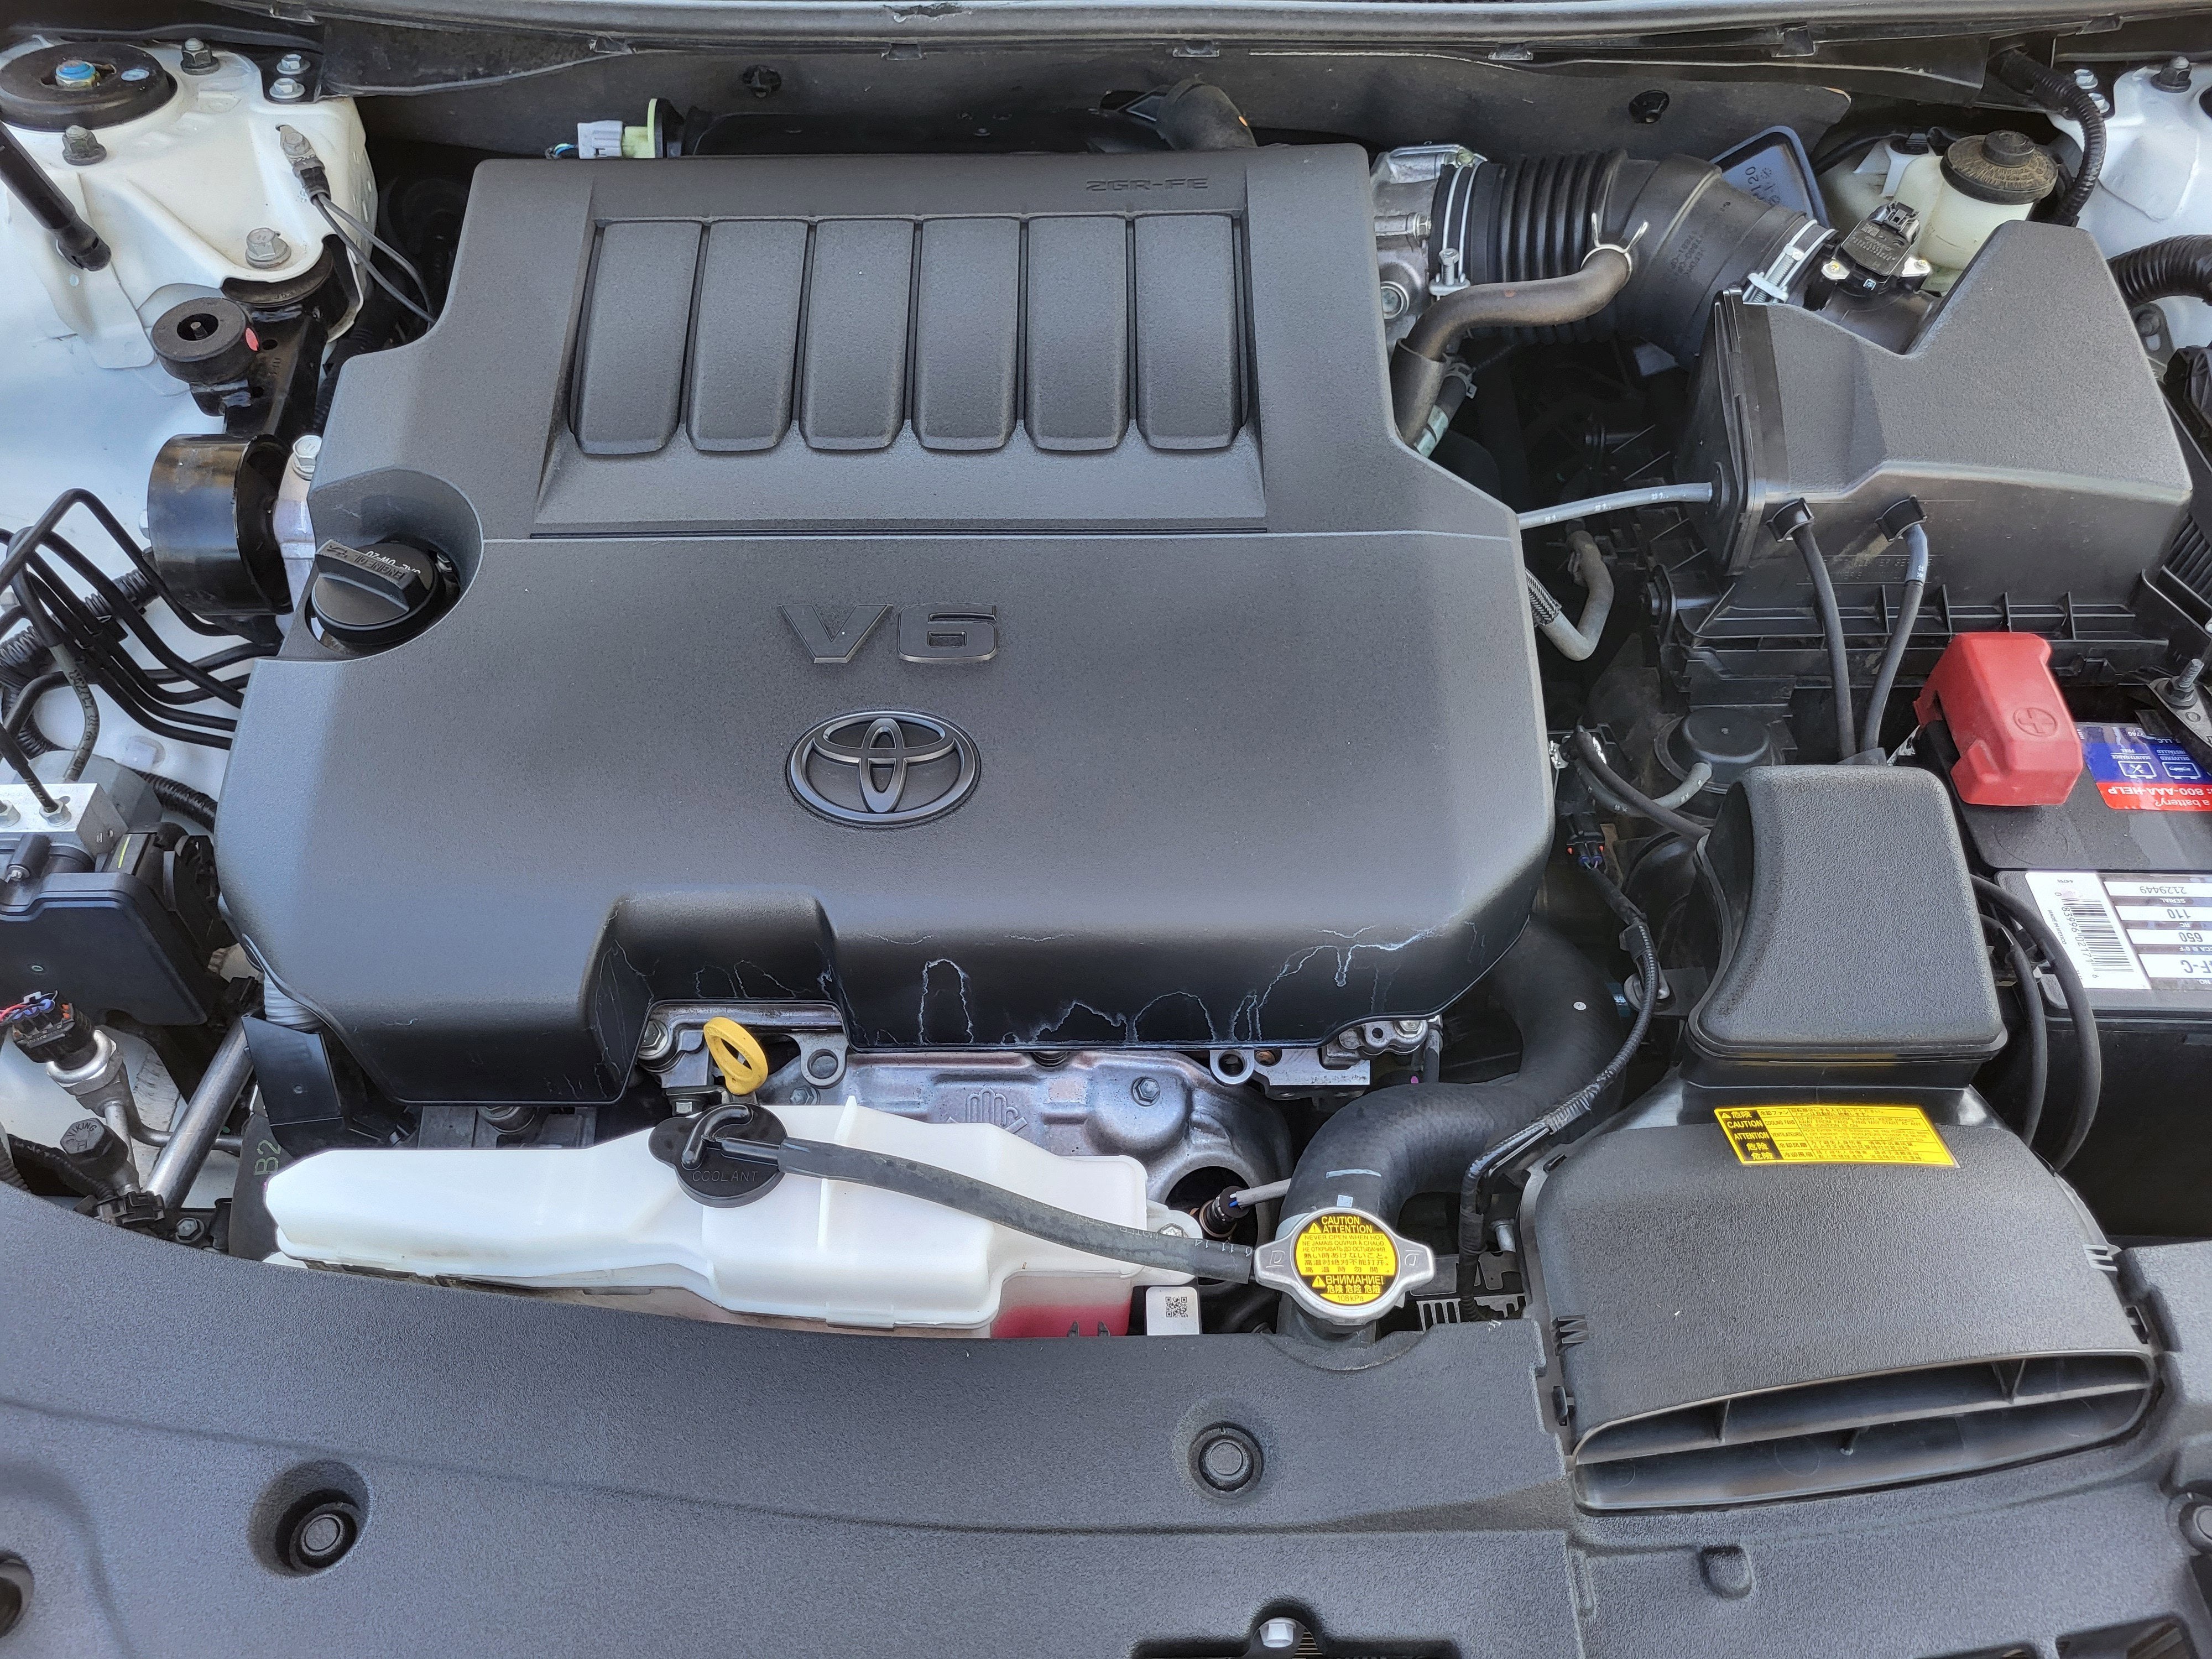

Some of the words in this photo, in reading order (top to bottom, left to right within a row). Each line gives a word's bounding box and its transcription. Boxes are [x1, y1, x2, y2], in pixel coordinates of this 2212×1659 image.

[1086, 179, 1208, 191] 2GR-FE
[353, 554, 368, 566] OIL
[368, 560, 405, 580] ENGINE
[778, 603, 998, 664] V6
[2107, 786, 2205, 795] 800-AAA-HELP
[2154, 799, 2201, 807] battery?
[2140, 885, 2187, 894] 2129449
[2167, 909, 2192, 919] 110
[2048, 910, 2056, 922] MADE
[2055, 927, 2067, 945] MEXICO
[2061, 906, 2078, 932] 83996
[2075, 936, 2094, 963] 02171
[2179, 932, 2203, 942] 650
[66, 1122, 97, 1137] VIKING
[1727, 1120, 1764, 1129] CAUTION
[1734, 1131, 1770, 1141] ATTENTION
[1746, 1142, 1769, 1152] 危险
[254, 1140, 283, 1175] B2
[692, 1170, 758, 1181] COOLANT
[1321, 1216, 1360, 1225] CAUTION
[1323, 1225, 1373, 1233] ATTENTION
[1194, 1239, 1209, 1248] 14
[1326, 1275, 1384, 1285] ВНИМАНИЕ!
